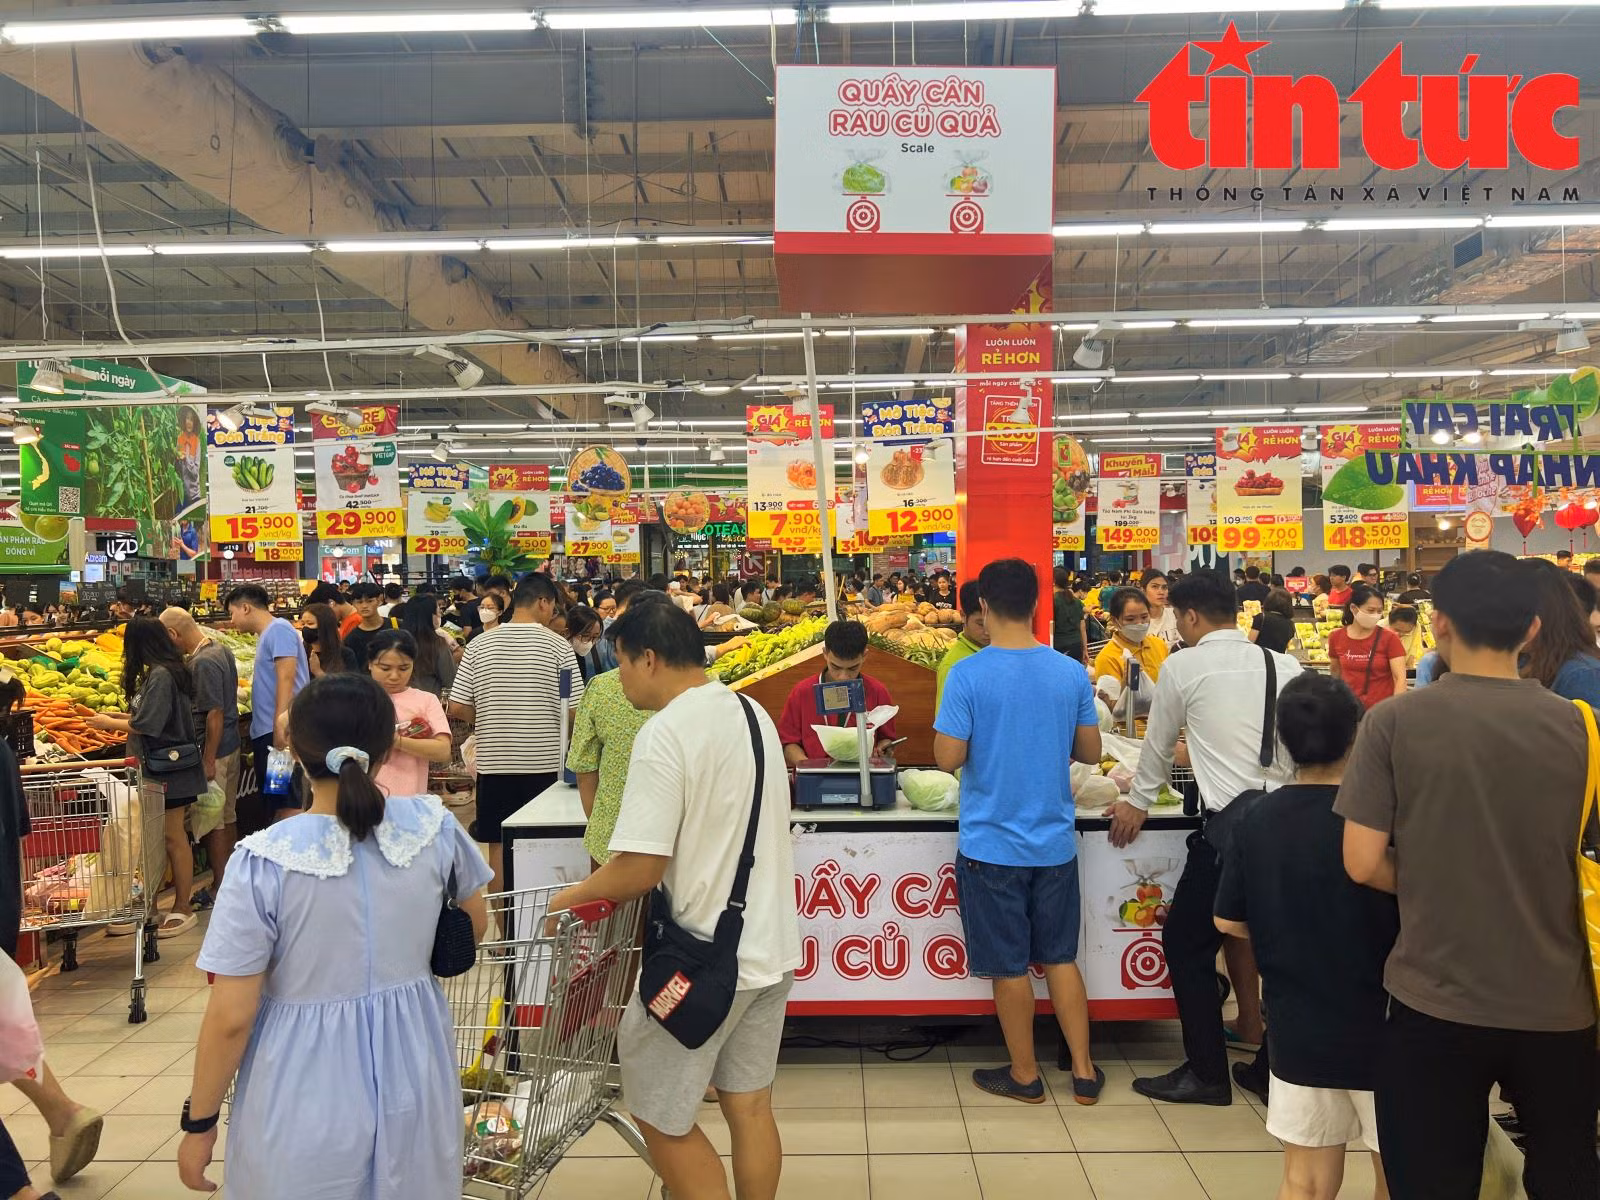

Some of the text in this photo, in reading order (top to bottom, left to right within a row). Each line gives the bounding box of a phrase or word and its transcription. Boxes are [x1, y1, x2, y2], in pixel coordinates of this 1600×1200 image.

[839, 74, 984, 106] QUẦY CÂN
[829, 105, 1003, 138] RAU CỦ QUẢ
[901, 142, 935, 153] Scale
[985, 337, 1036, 346] LUÔN LUÔN
[1004, 350, 1040, 364] HƠN
[111, 374, 136, 390] ngày
[226, 515, 294, 539] 15.900
[325, 511, 397, 535] 29.900
[887, 508, 953, 533] 12.900
[415, 537, 466, 553] 29.900
[1103, 528, 1158, 543] 149.000
[1223, 527, 1298, 549] 99.700
[1329, 525, 1401, 549] 48.500
[571, 542, 609, 555] 27.900
[795, 859, 960, 918] ẦY CÂ
[833, 921, 910, 981] CỦ
[649, 970, 693, 1020] MARVEL
